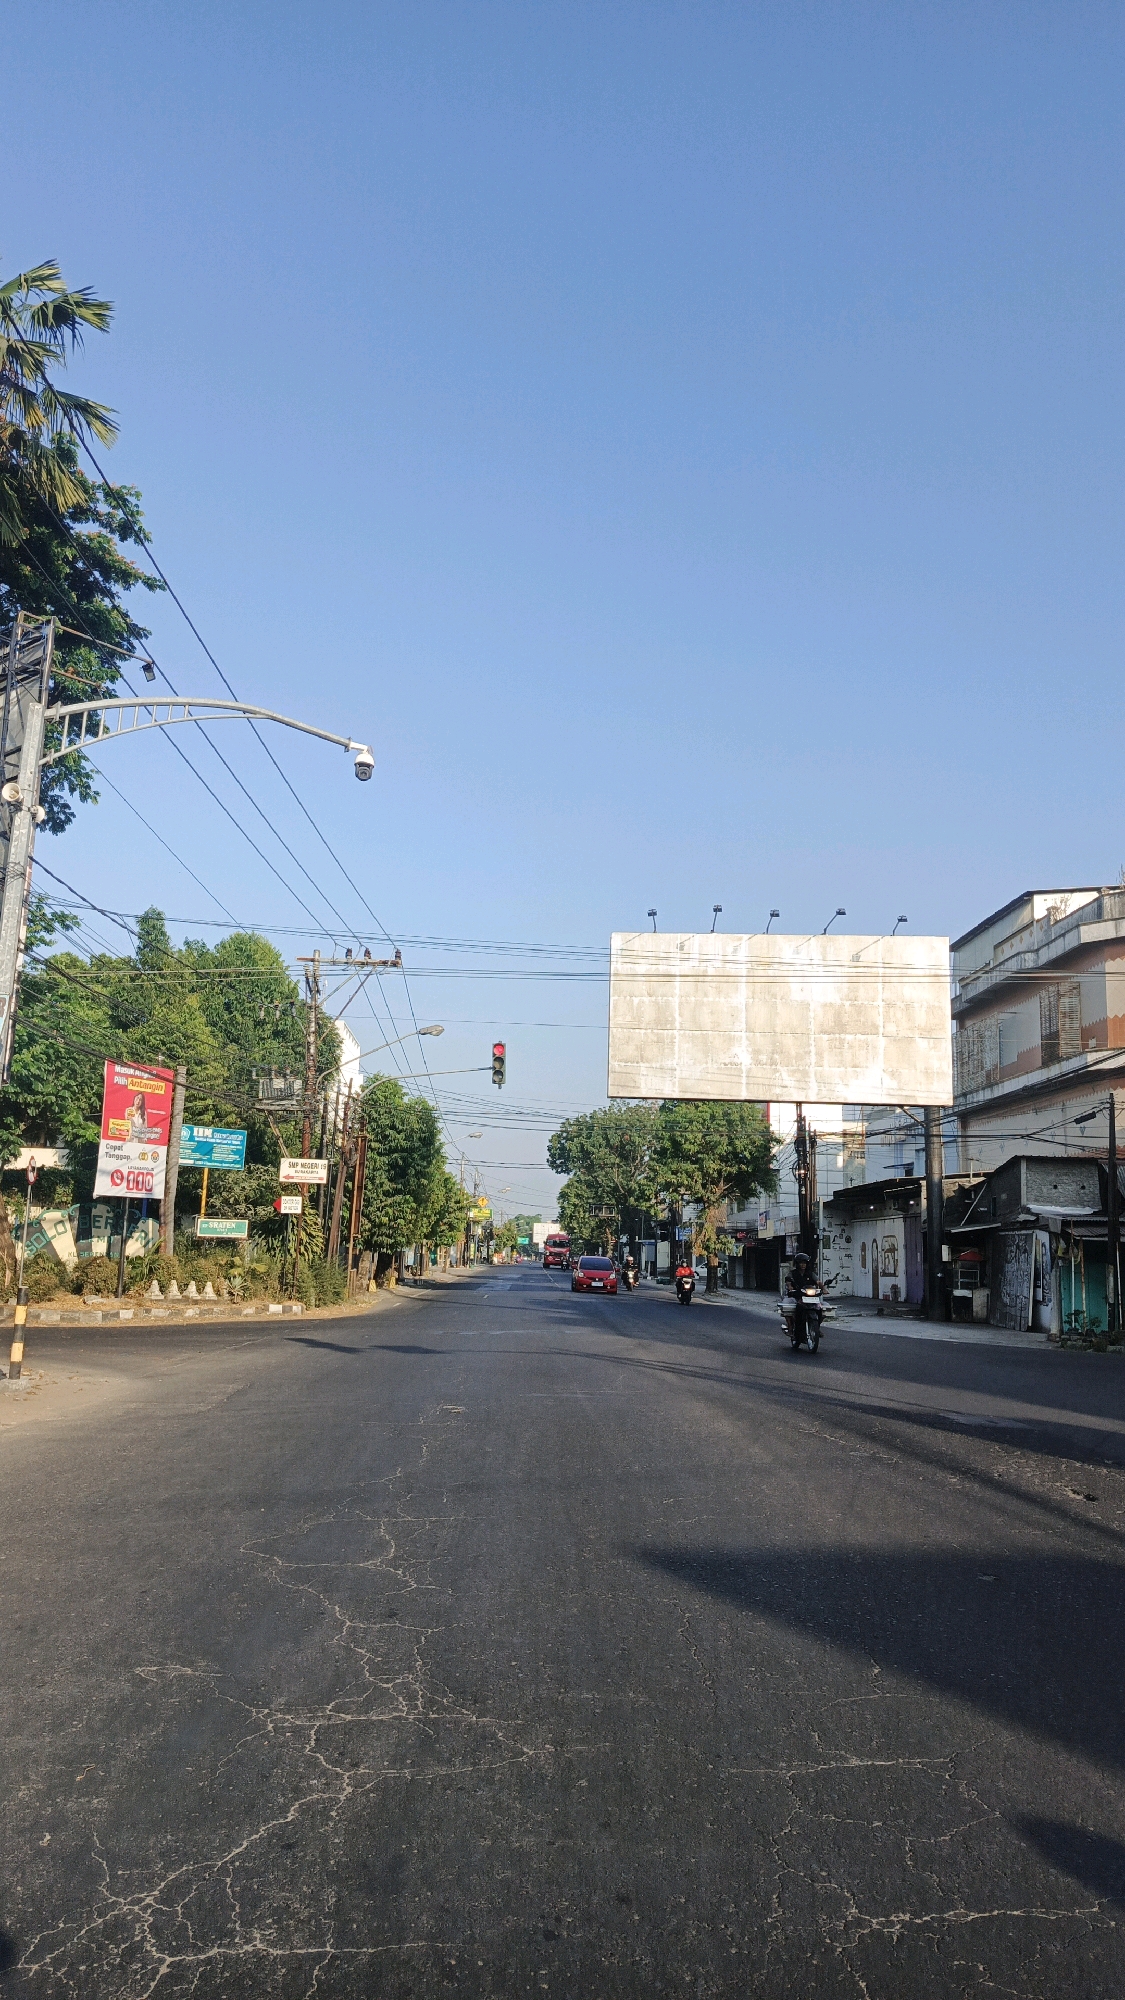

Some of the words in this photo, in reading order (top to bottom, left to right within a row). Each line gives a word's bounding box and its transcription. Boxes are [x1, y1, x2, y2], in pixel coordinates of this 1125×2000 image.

[114, 1065, 135, 1075] Masuk
[114, 1076, 128, 1086] Pilih
[128, 1079, 164, 1092] Antangin
[288, 1161, 299, 1169] SMP
[300, 1162, 319, 1170] NEGERI
[126, 1171, 154, 1191] 110
[208, 1221, 237, 1229] SRATEN
[25, 1220, 68, 1257] SOLO
[79, 1215, 154, 1248] BERSERI
